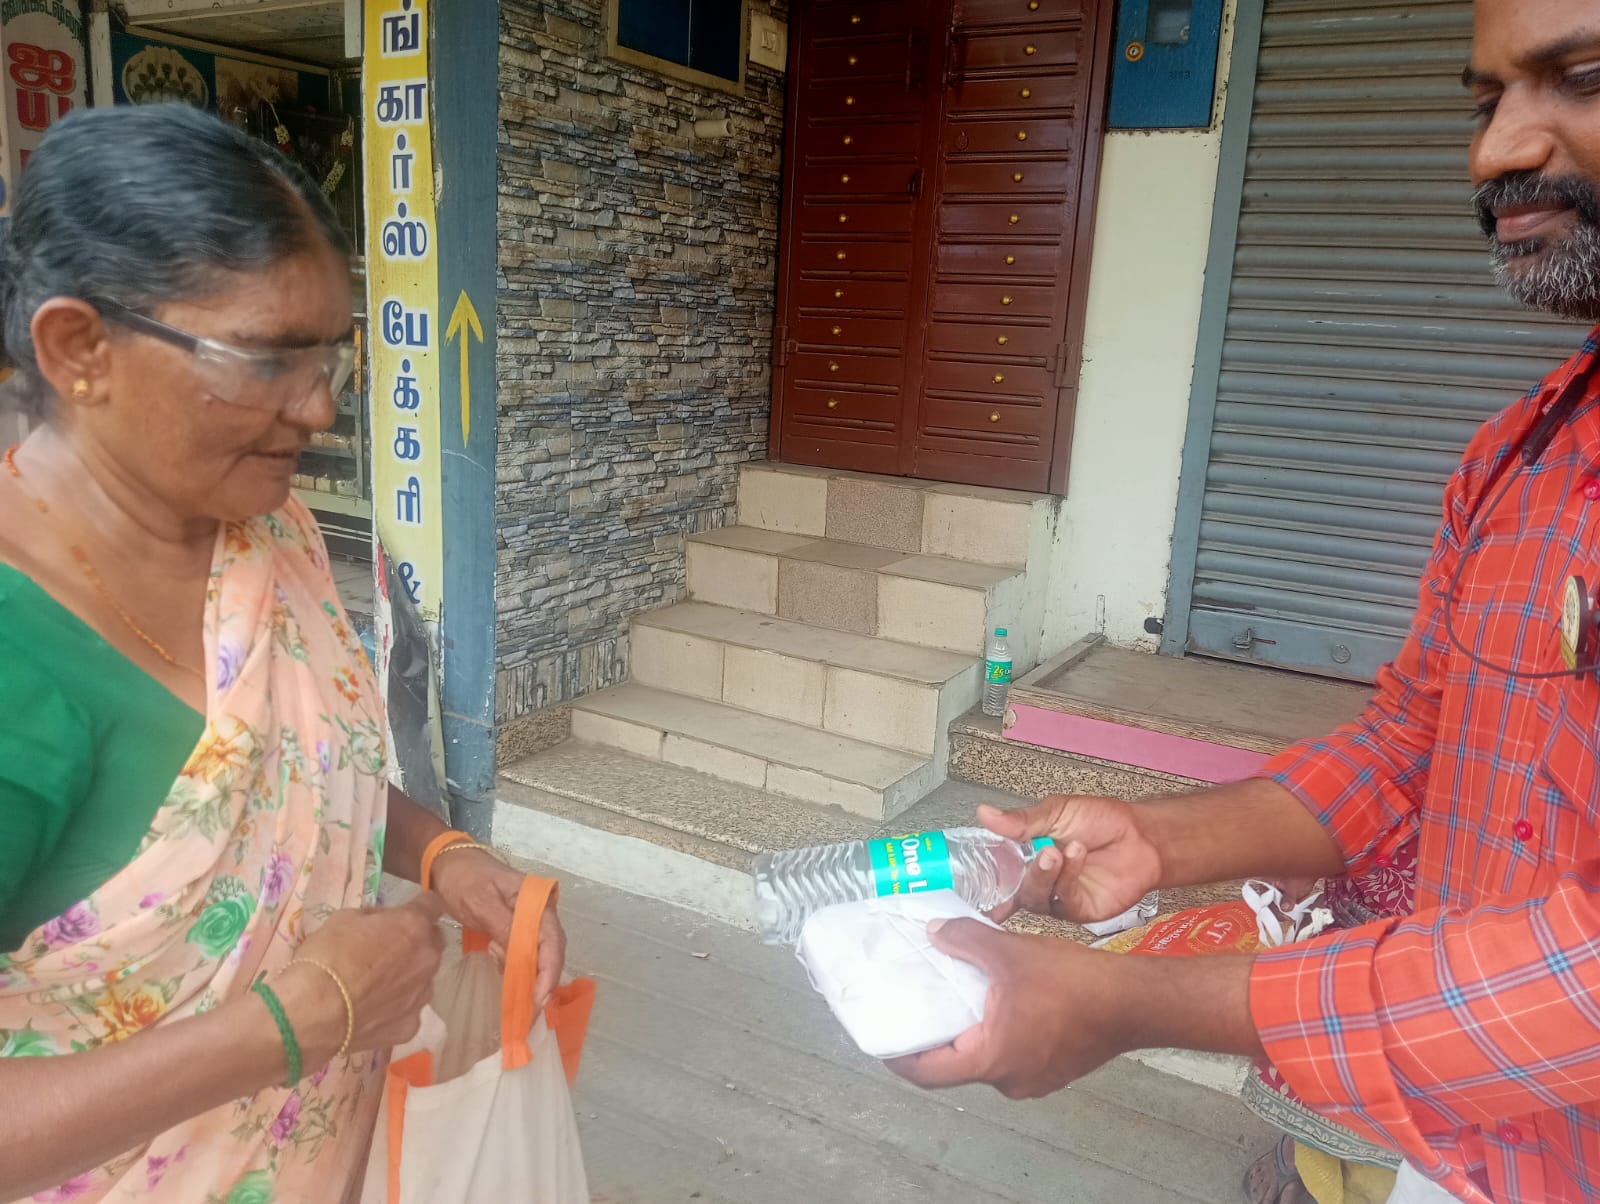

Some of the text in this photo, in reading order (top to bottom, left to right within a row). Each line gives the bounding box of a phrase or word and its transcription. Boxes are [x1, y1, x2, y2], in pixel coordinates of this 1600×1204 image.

[382, 299, 429, 525] பேக்கரி
[398, 561, 421, 605] &
[901, 838, 921, 876] One
